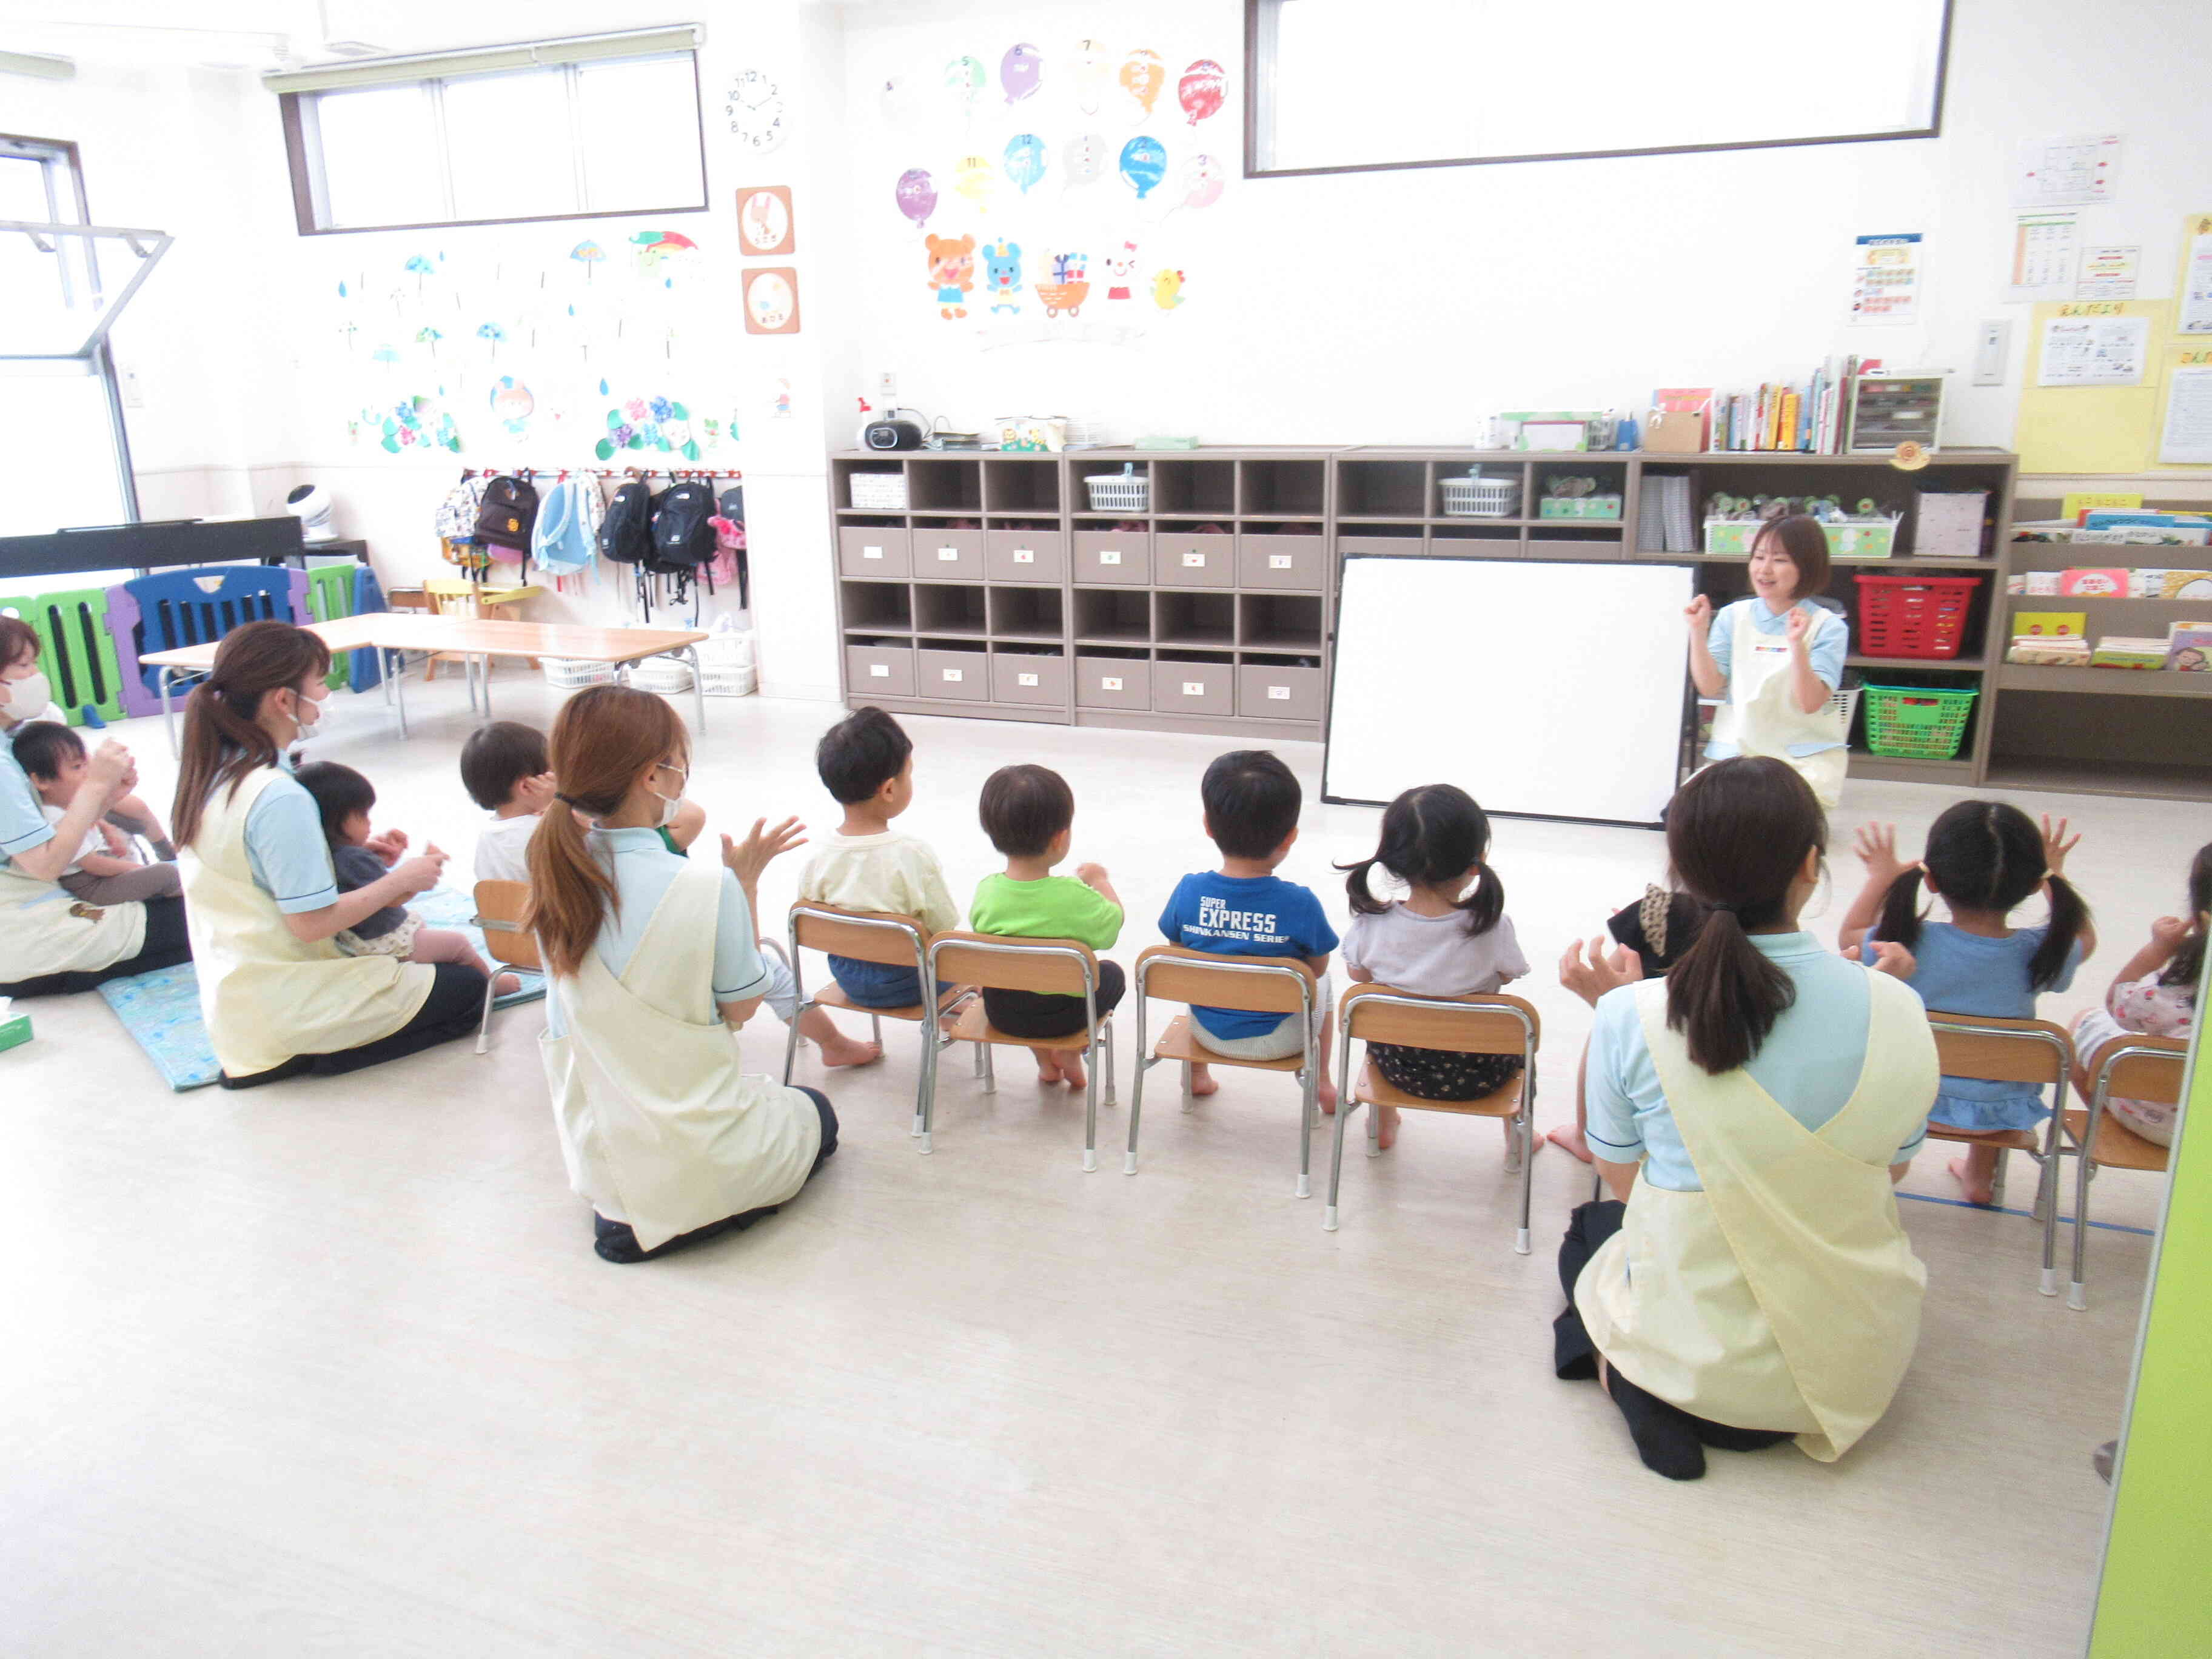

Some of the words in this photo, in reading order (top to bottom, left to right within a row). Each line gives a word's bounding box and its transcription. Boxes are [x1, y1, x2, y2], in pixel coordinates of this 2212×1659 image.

[1082, 39, 1091, 51] 7
[745, 70, 757, 83] 12
[734, 78, 745, 88] 11
[728, 90, 740, 101] 10
[771, 84, 779, 95] 2
[725, 105, 734, 116] 9
[731, 121, 739, 133] 8
[772, 116, 781, 128] 4
[742, 132, 748, 142] 7
[752, 135, 761, 147] 6
[766, 130, 774, 141] 5
[967, 157, 976, 168] 11
[1200, 896, 1226, 910] SUPER
[1199, 907, 1276, 933] EXPRESS
[1183, 924, 1249, 940] SHINKANSEN
